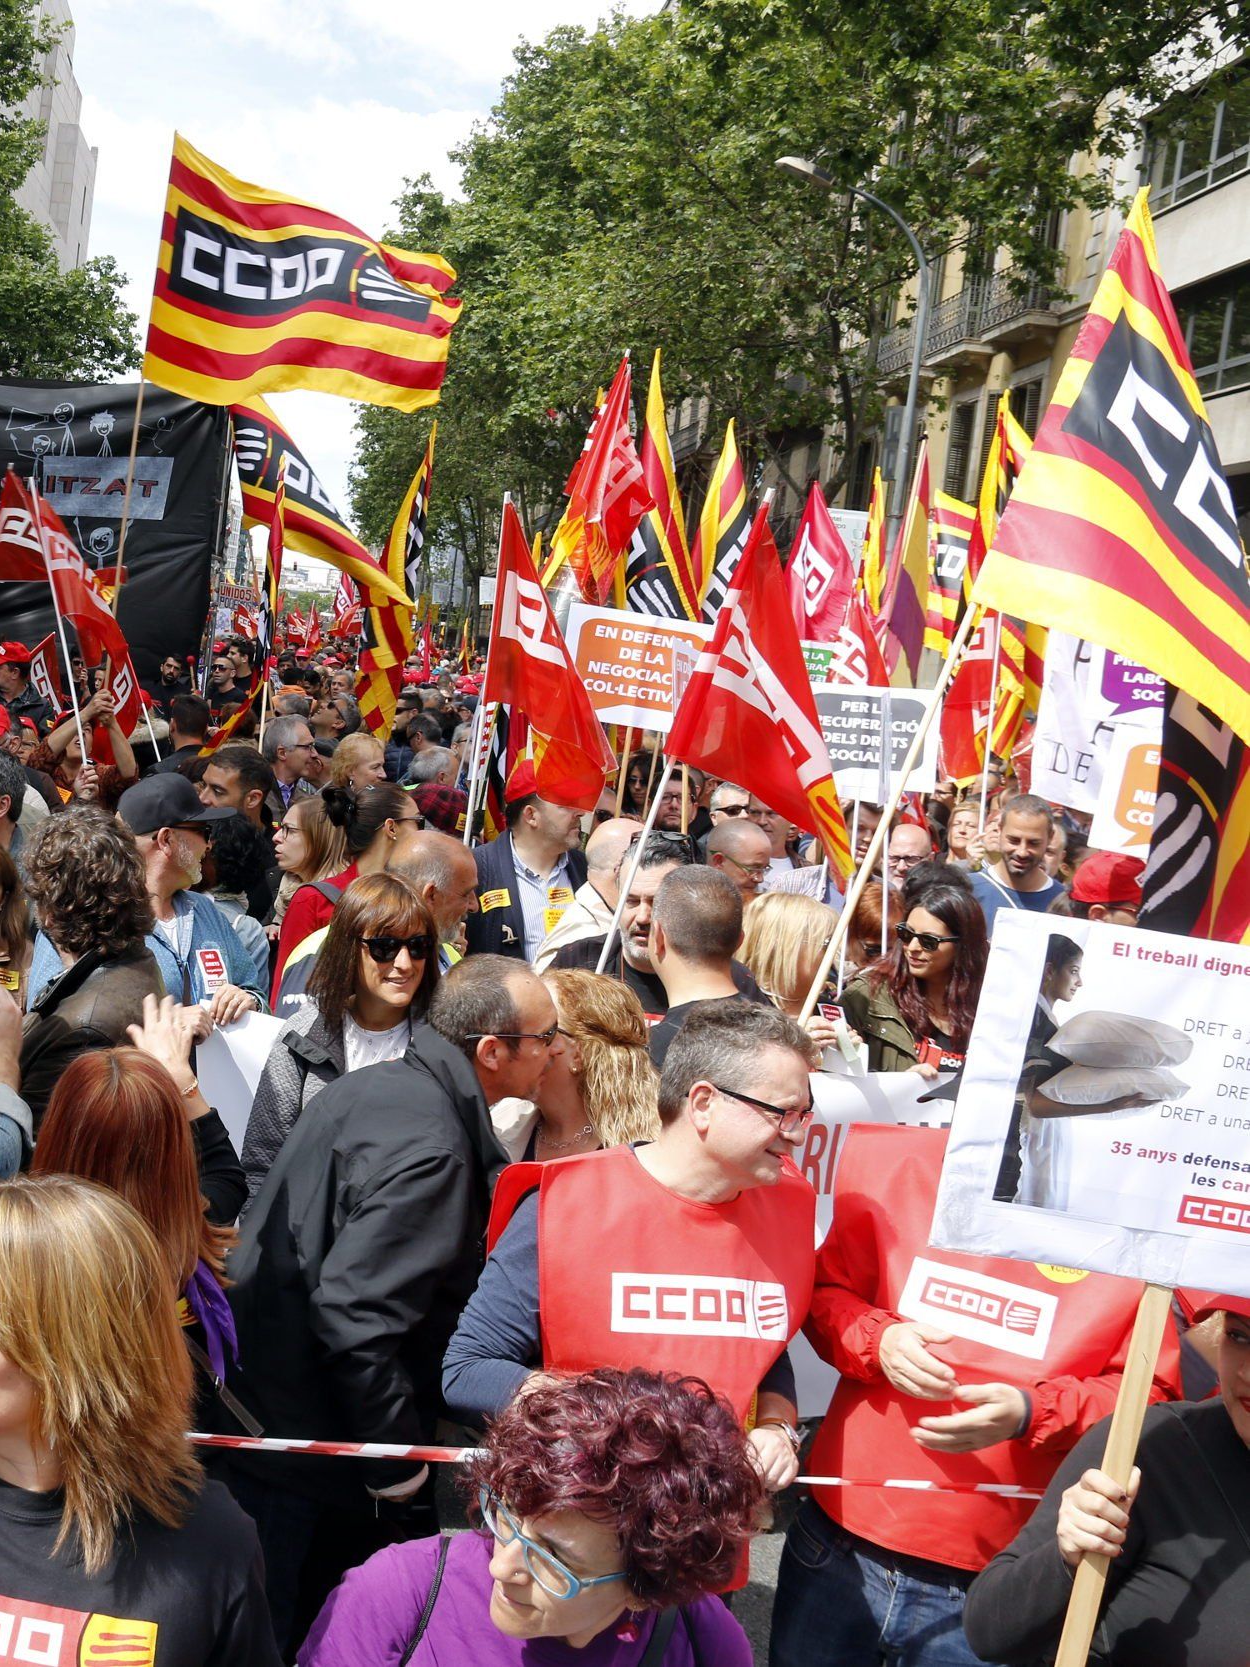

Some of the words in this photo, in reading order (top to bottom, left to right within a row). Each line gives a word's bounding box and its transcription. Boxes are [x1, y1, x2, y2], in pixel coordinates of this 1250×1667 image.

[181, 229, 346, 300] CCOO
[220, 585, 252, 602] UNIDOS
[594, 624, 619, 640] EN
[618, 646, 641, 662] DE
[644, 649, 666, 666] LA
[811, 650, 826, 662] LA
[587, 660, 673, 687] NEGOCIAC
[583, 678, 673, 706] COL·LECTIV
[1131, 689, 1165, 703] SOC
[840, 700, 870, 714] PER
[818, 713, 920, 735] ECUPERCIÓ
[822, 731, 857, 746] DELS
[859, 734, 909, 749] DRTS
[1112, 941, 1130, 958] El
[1136, 945, 1199, 969] treball
[1203, 955, 1250, 977] digne
[1183, 1018, 1228, 1038] DRET
[1232, 1028, 1242, 1040] a
[1160, 1104, 1205, 1124] DRET
[1208, 1114, 1217, 1125] a
[1222, 1116, 1250, 1131] una
[1110, 1140, 1132, 1156] 35
[1136, 1146, 1178, 1165] anys
[1190, 1172, 1217, 1189] les
[622, 1285, 747, 1324] CCOO
[925, 1282, 1002, 1320] CCOO
